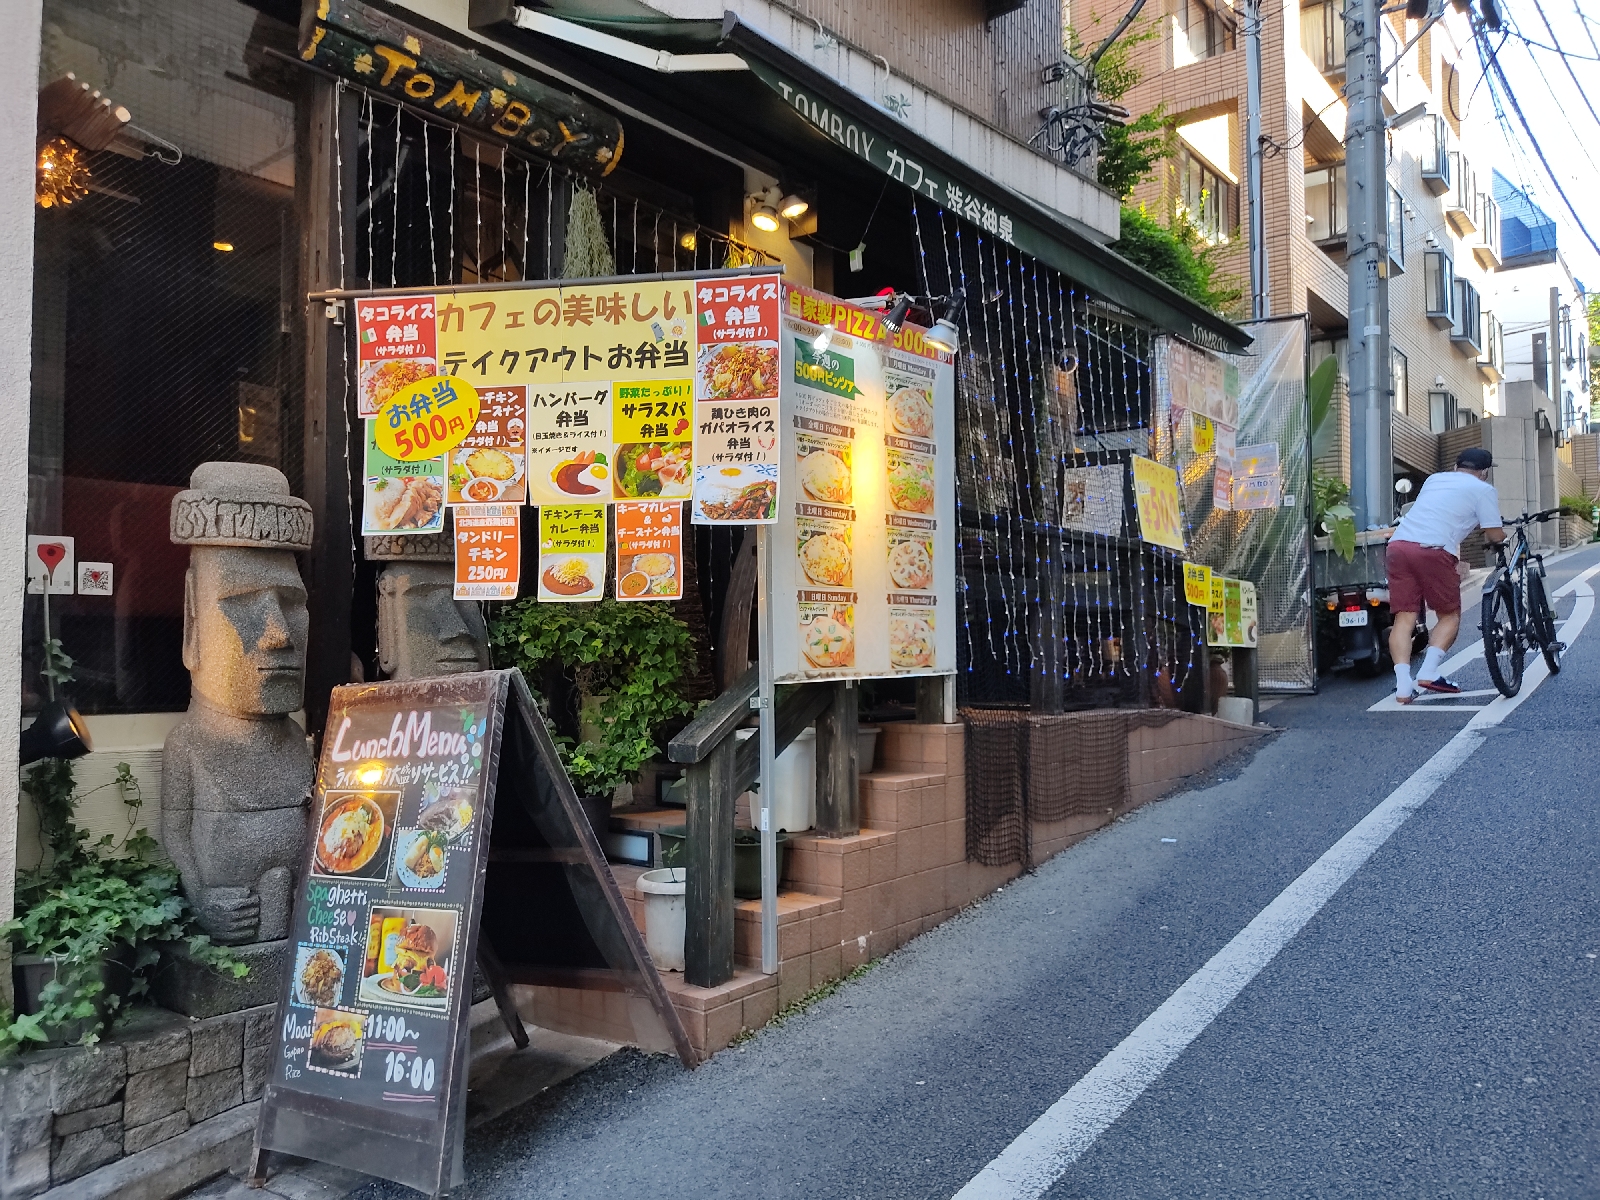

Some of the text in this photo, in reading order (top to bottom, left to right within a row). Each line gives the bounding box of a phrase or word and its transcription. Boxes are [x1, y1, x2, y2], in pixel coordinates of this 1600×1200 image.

[778, 81, 1015, 246] TOMBOY カフェ 渋谷神泉
[698, 283, 777, 304] タコライス
[360, 303, 434, 322] タコライス
[437, 290, 692, 333] カフェの美味しい
[725, 305, 760, 325] 弁当
[386, 324, 418, 343] 弁当
[1191, 322, 1229, 352] TOMBOY
[444, 340, 688, 377] テイクアウトお弁当
[386, 380, 458, 429] お弁当
[533, 389, 608, 408] ハンバーグ
[555, 410, 589, 428] 弁当
[621, 401, 687, 419] サラスパ
[711, 406, 771, 420] 鶏ひき肉の
[476, 420, 498, 434] 弁当
[640, 423, 669, 438] 弁当
[700, 420, 775, 434] ガパオライス
[531, 445, 578, 455] ※イメージです
[726, 438, 751, 449] 弁当
[543, 509, 603, 520] チキンチーズ
[617, 502, 680, 515] キーマカレー
[458, 531, 515, 544] タンドリー
[550, 523, 599, 534] カレー弁当
[617, 525, 680, 538] チーズナン弁当
[468, 548, 507, 561] チキン
[332, 710, 467, 762] Lunch Menu
[307, 879, 368, 907] Spaghetti
[307, 903, 347, 927] Cheese
[283, 1013, 312, 1042] Moai
[285, 1051, 435, 1091] Rice 16:00
